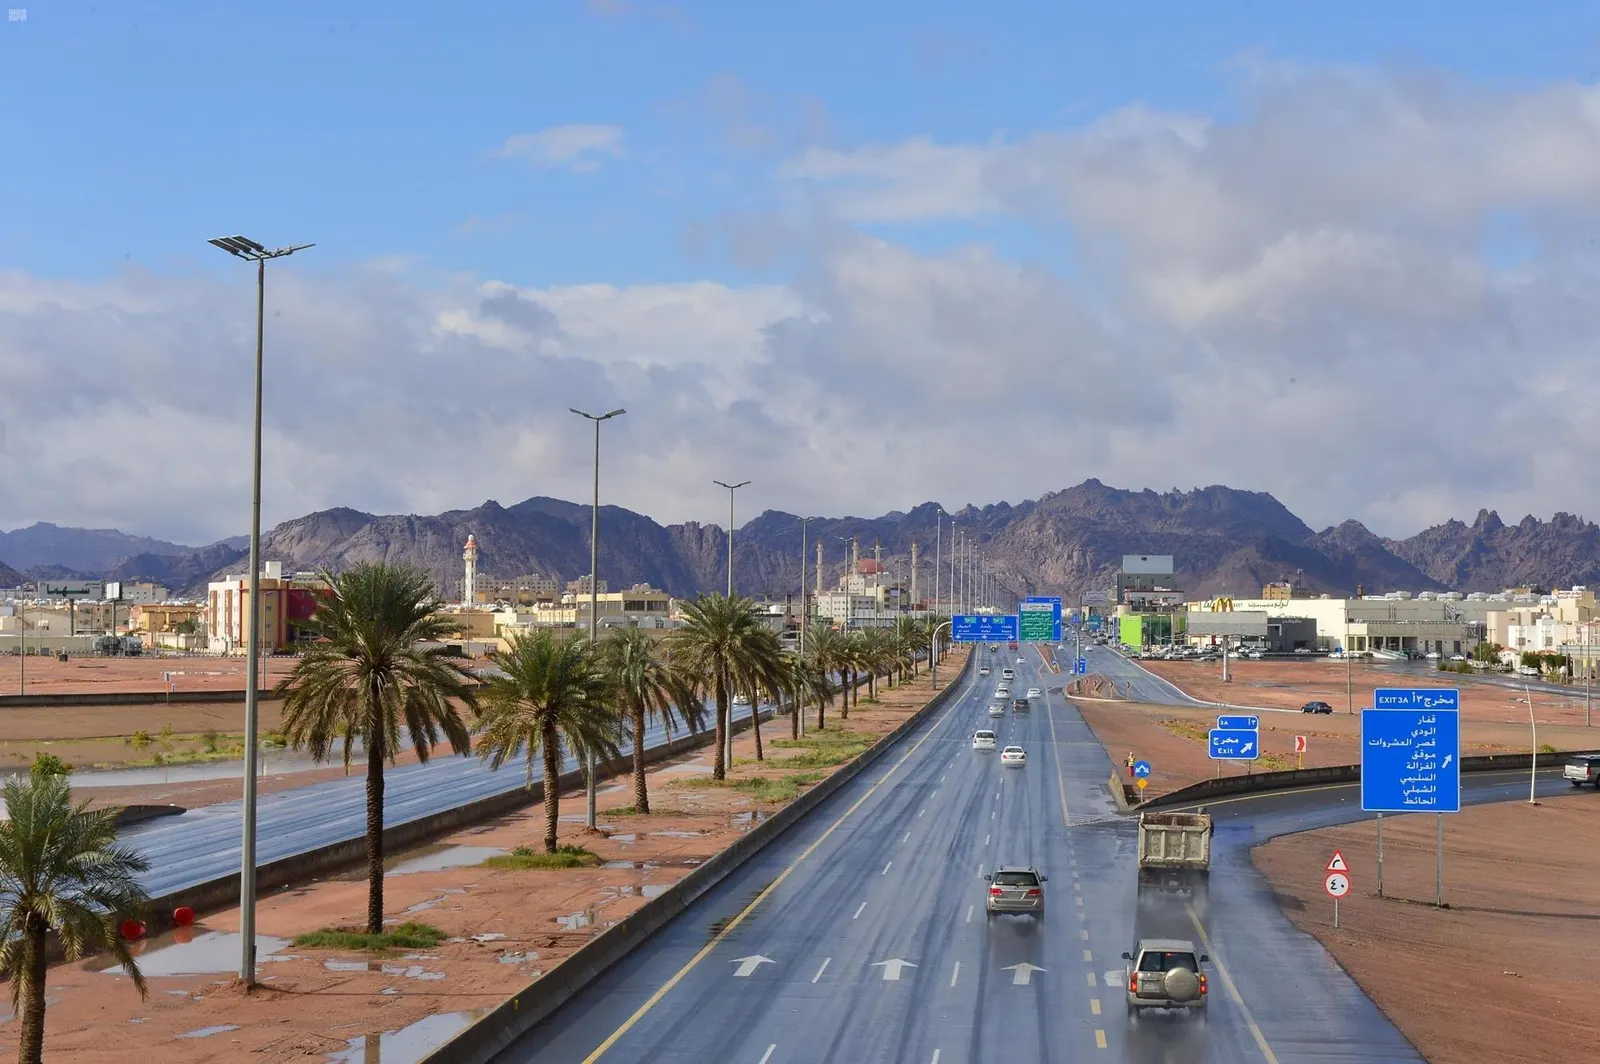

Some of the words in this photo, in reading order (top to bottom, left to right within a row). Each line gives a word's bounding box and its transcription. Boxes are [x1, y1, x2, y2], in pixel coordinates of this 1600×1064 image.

[1379, 696, 1397, 704] EXIT
[1397, 696, 1409, 704] 3A
[1423, 695, 1454, 708] مخرج
[1417, 714, 1436, 725] قفار
[1410, 727, 1436, 738] الودي
[1213, 736, 1239, 746] مخرج
[1415, 737, 1436, 748] قصر
[1411, 749, 1436, 760] موقق
[1406, 761, 1436, 771] الغزالة
[1399, 773, 1436, 785] السليمي
[1402, 785, 1436, 797] الشملي
[1402, 796, 1436, 805] الحائط
[1330, 878, 1345, 891] ٤٠
